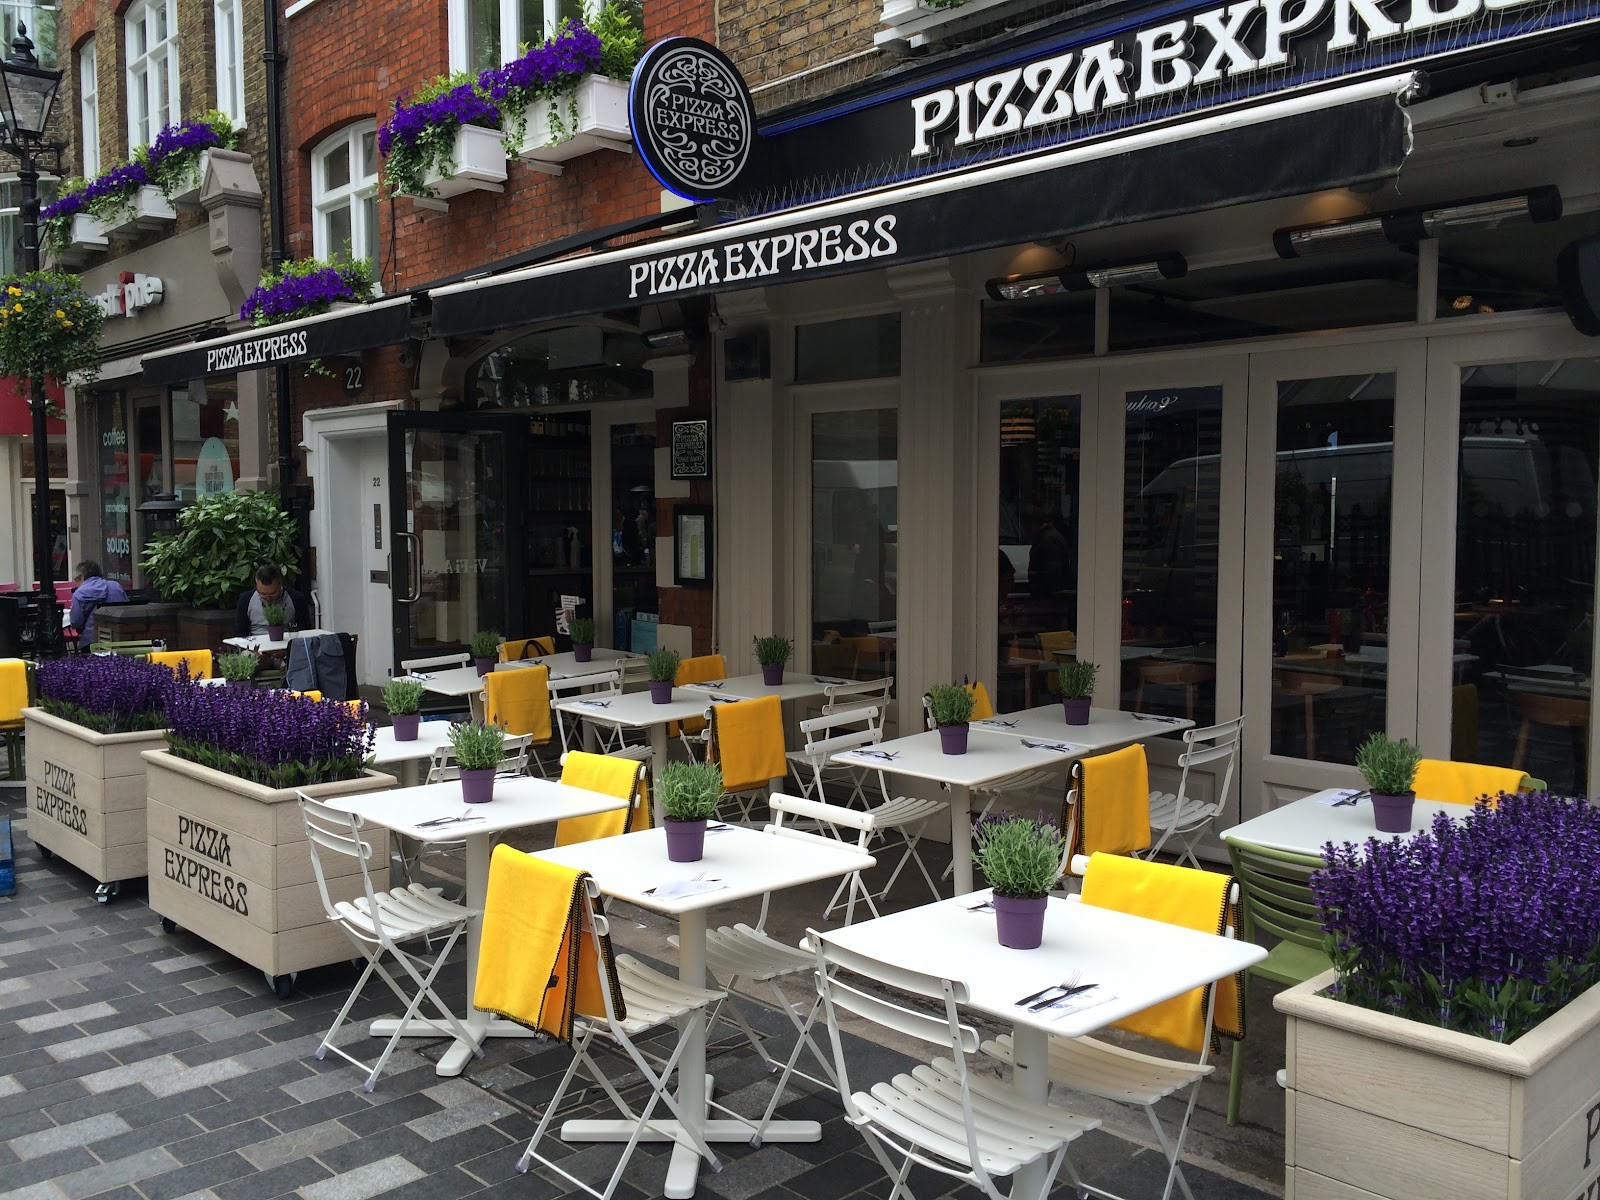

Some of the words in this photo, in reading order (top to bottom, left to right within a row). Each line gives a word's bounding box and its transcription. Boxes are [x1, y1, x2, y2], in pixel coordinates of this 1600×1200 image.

[672, 93, 725, 121] PIZZA
[656, 107, 740, 141] EXPRESS
[345, 367, 362, 389] 22
[103, 426, 126, 446] coffee
[372, 477, 381, 487] 22
[106, 537, 130, 558] soups
[44, 760, 77, 800] PIZZA
[36, 786, 88, 836] EXPRESS
[178, 815, 232, 867] PIZZA
[164, 848, 249, 917] EXPRESS
